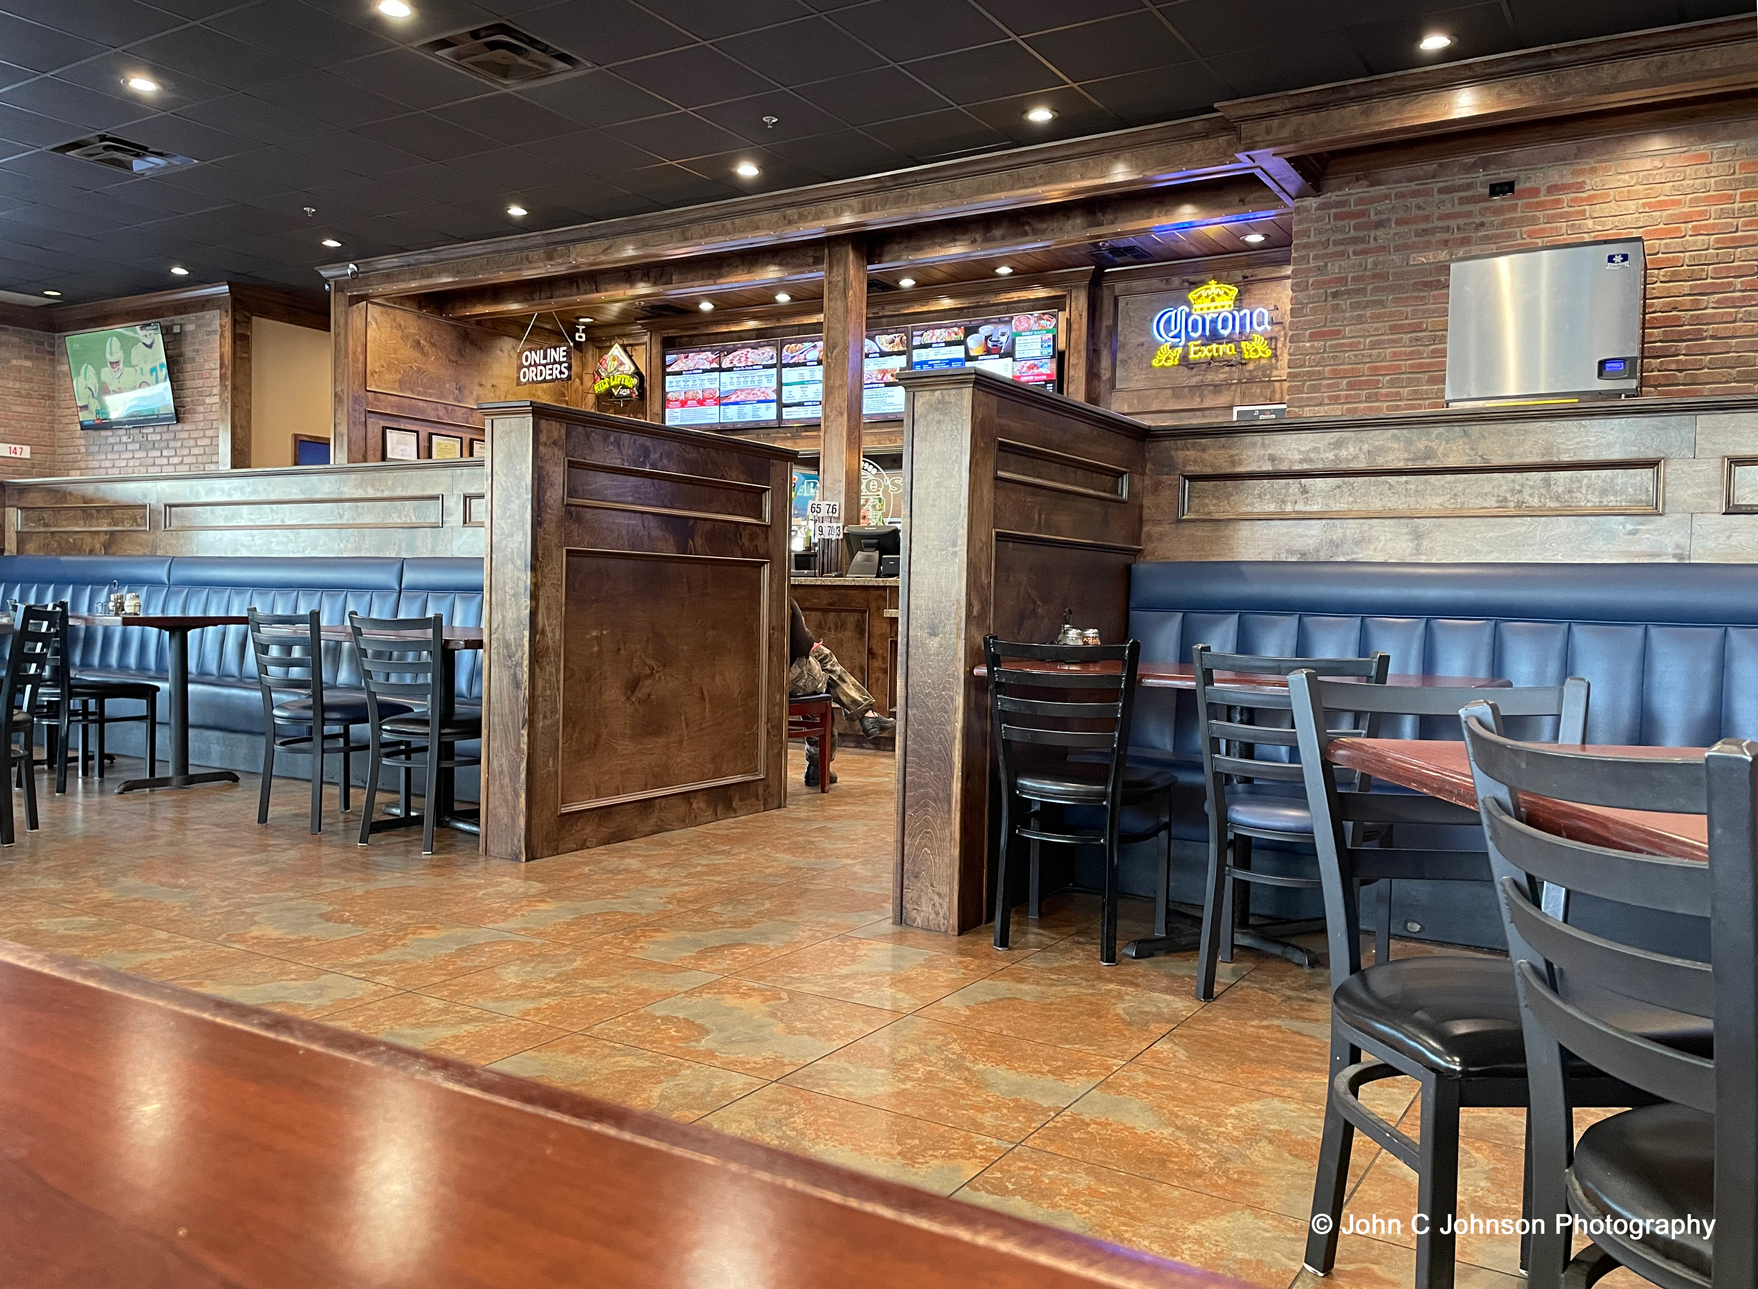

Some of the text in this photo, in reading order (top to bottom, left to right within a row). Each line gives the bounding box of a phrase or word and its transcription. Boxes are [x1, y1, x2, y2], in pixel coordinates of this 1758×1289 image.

[1152, 305, 1272, 346] Corona
[521, 346, 567, 366] ONLINE
[1187, 340, 1236, 359] Extra
[520, 362, 569, 383] ORDERS
[8, 446, 24, 457] 147
[810, 502, 822, 514] 65
[826, 503, 838, 515] 76
